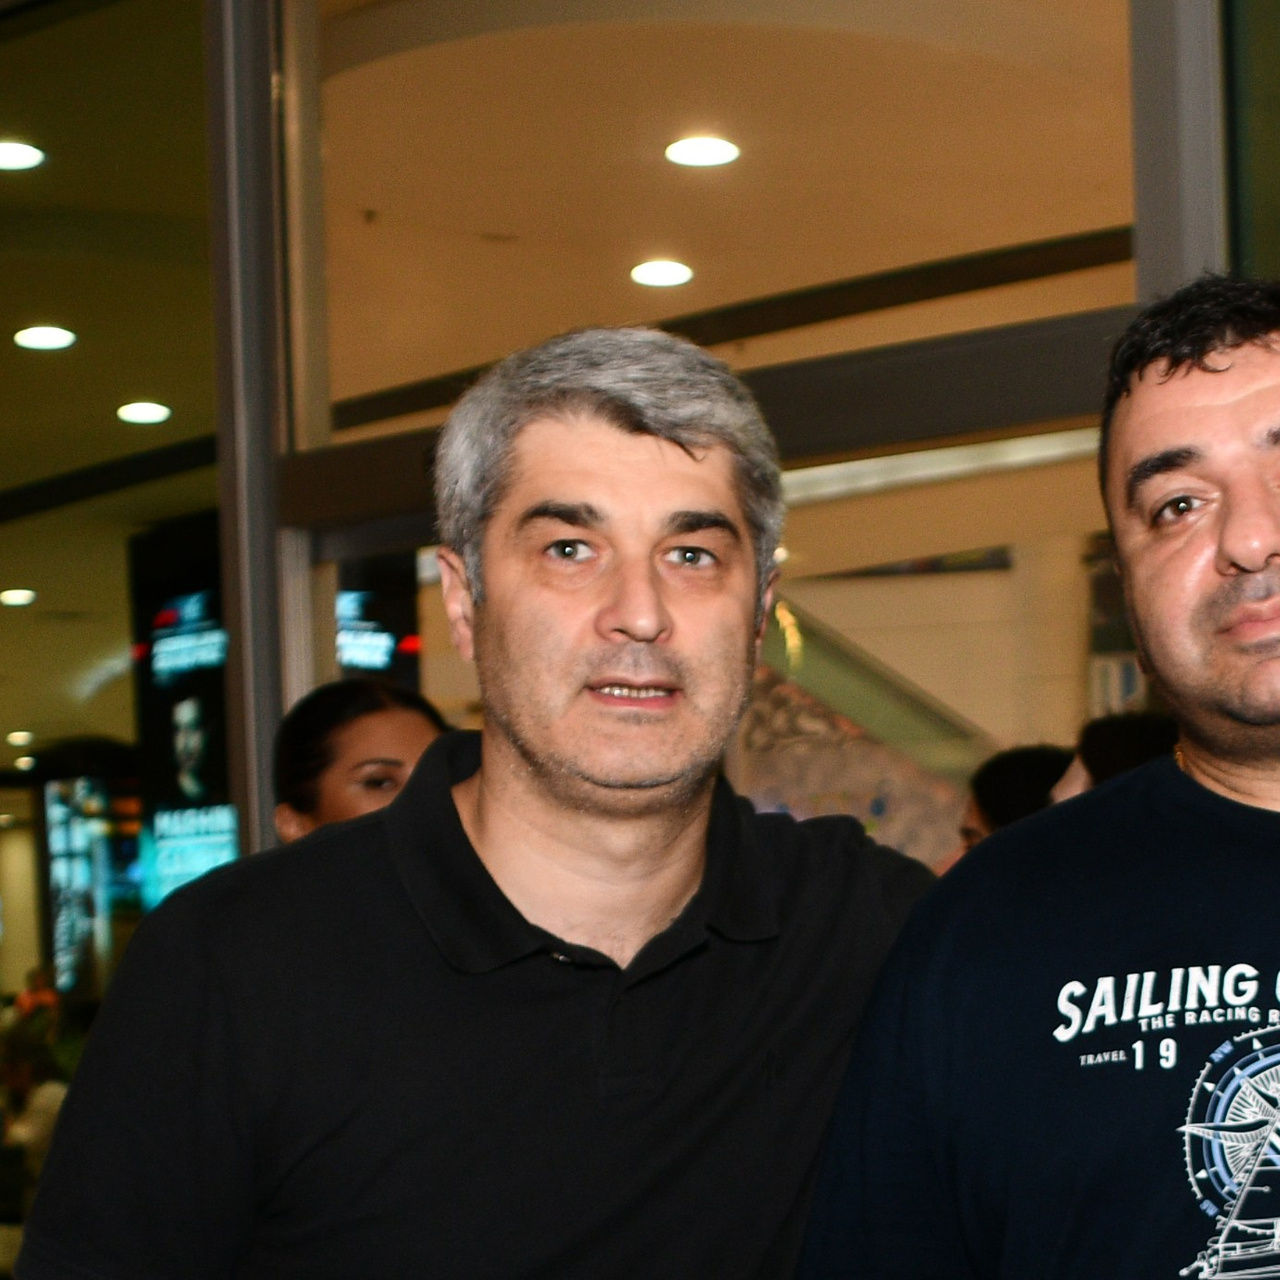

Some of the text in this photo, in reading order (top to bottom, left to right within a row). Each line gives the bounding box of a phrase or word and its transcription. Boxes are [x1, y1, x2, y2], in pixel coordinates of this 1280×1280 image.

[1052, 962, 1259, 1043] SAILING
[1139, 1013, 1176, 1032] THE
[1184, 1006, 1261, 1026] RACING
[1079, 1051, 1127, 1067] TRAVEL
